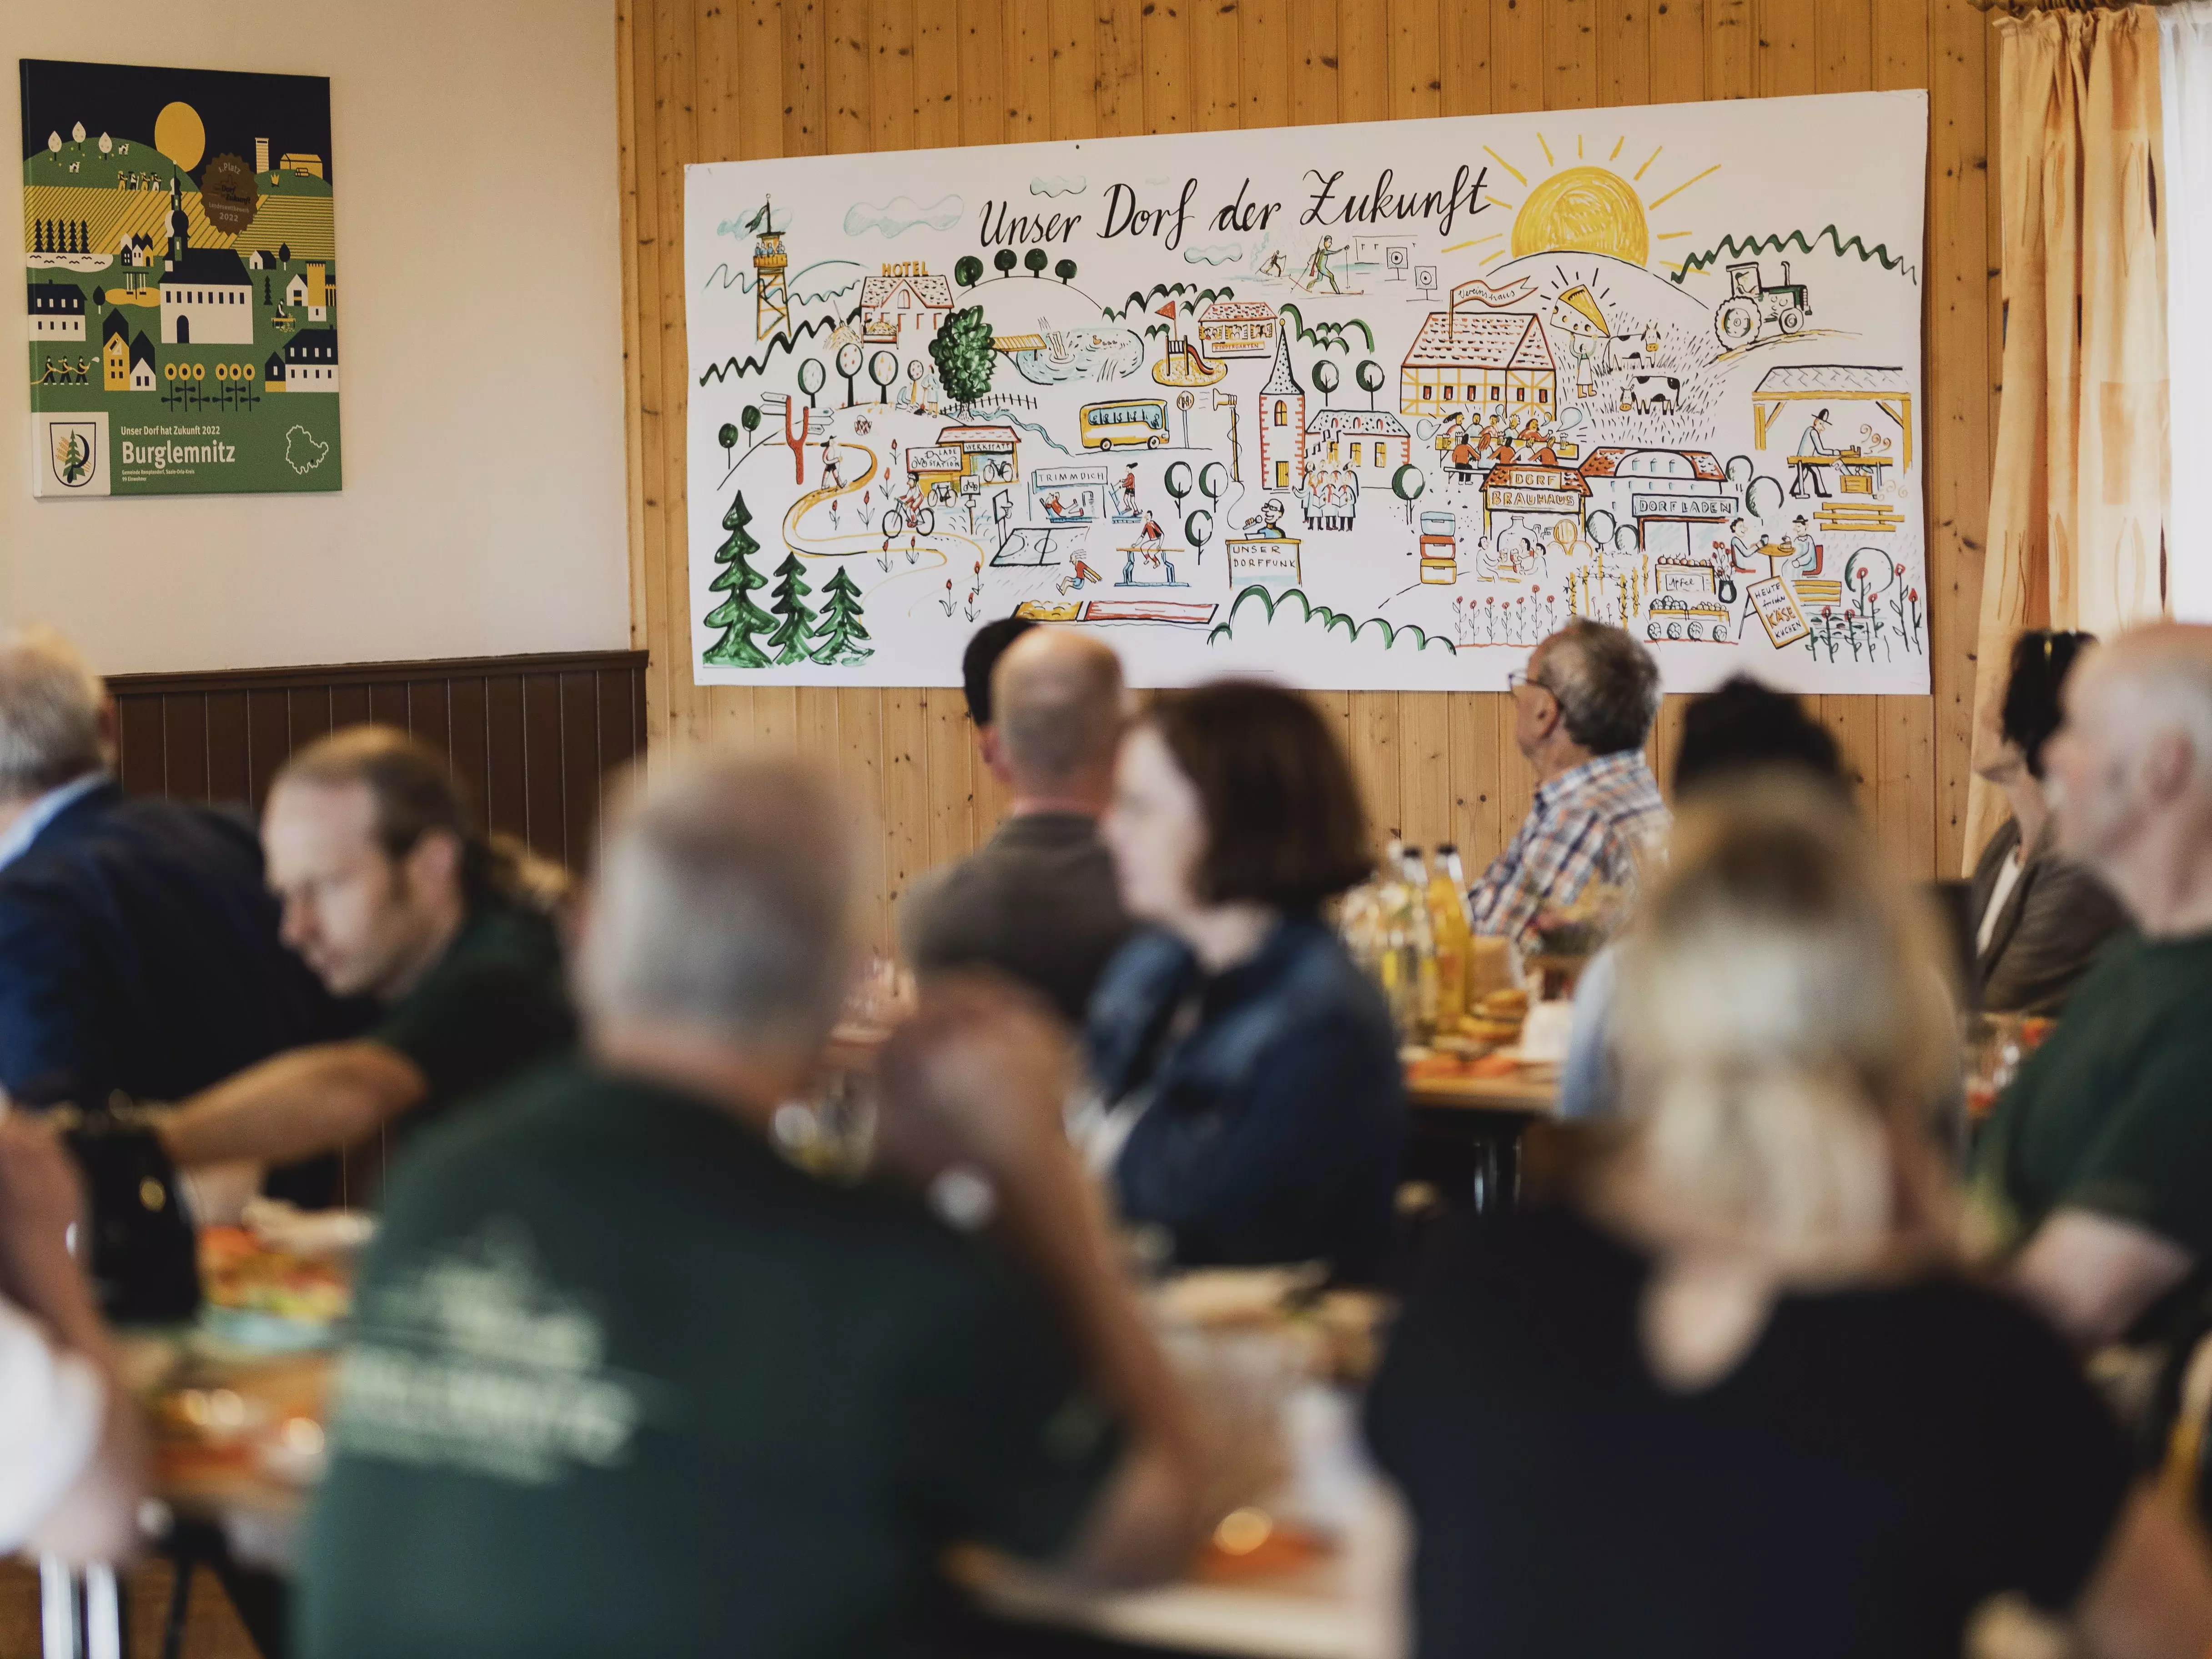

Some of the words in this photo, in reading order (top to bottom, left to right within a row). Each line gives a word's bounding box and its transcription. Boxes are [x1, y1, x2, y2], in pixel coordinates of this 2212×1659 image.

[979, 201, 1081, 247] Unser
[1096, 178, 1197, 251] Dorf
[1209, 178, 1281, 231] der
[1299, 165, 1492, 236] Zukunft
[220, 212, 238, 222] 2022
[882, 261, 929, 277] HOTEL
[121, 426, 142, 435] Unser
[144, 426, 159, 435] Dorf
[160, 426, 172, 435] hat
[173, 425, 201, 435] Zukunft
[202, 426, 220, 435] 2022
[122, 439, 235, 469] Burglemnitz
[965, 443, 1010, 451] WERKSTATT
[929, 459, 960, 468] STATION
[1515, 474, 1557, 485] DORF
[1492, 491, 1574, 506] BRAUHAUS
[1234, 558, 1295, 568] DORFFUNK
[1755, 582, 1780, 599] HEUTE
[1766, 606, 1796, 629] KÄSE
[1775, 620, 1801, 640] KUCHEN
